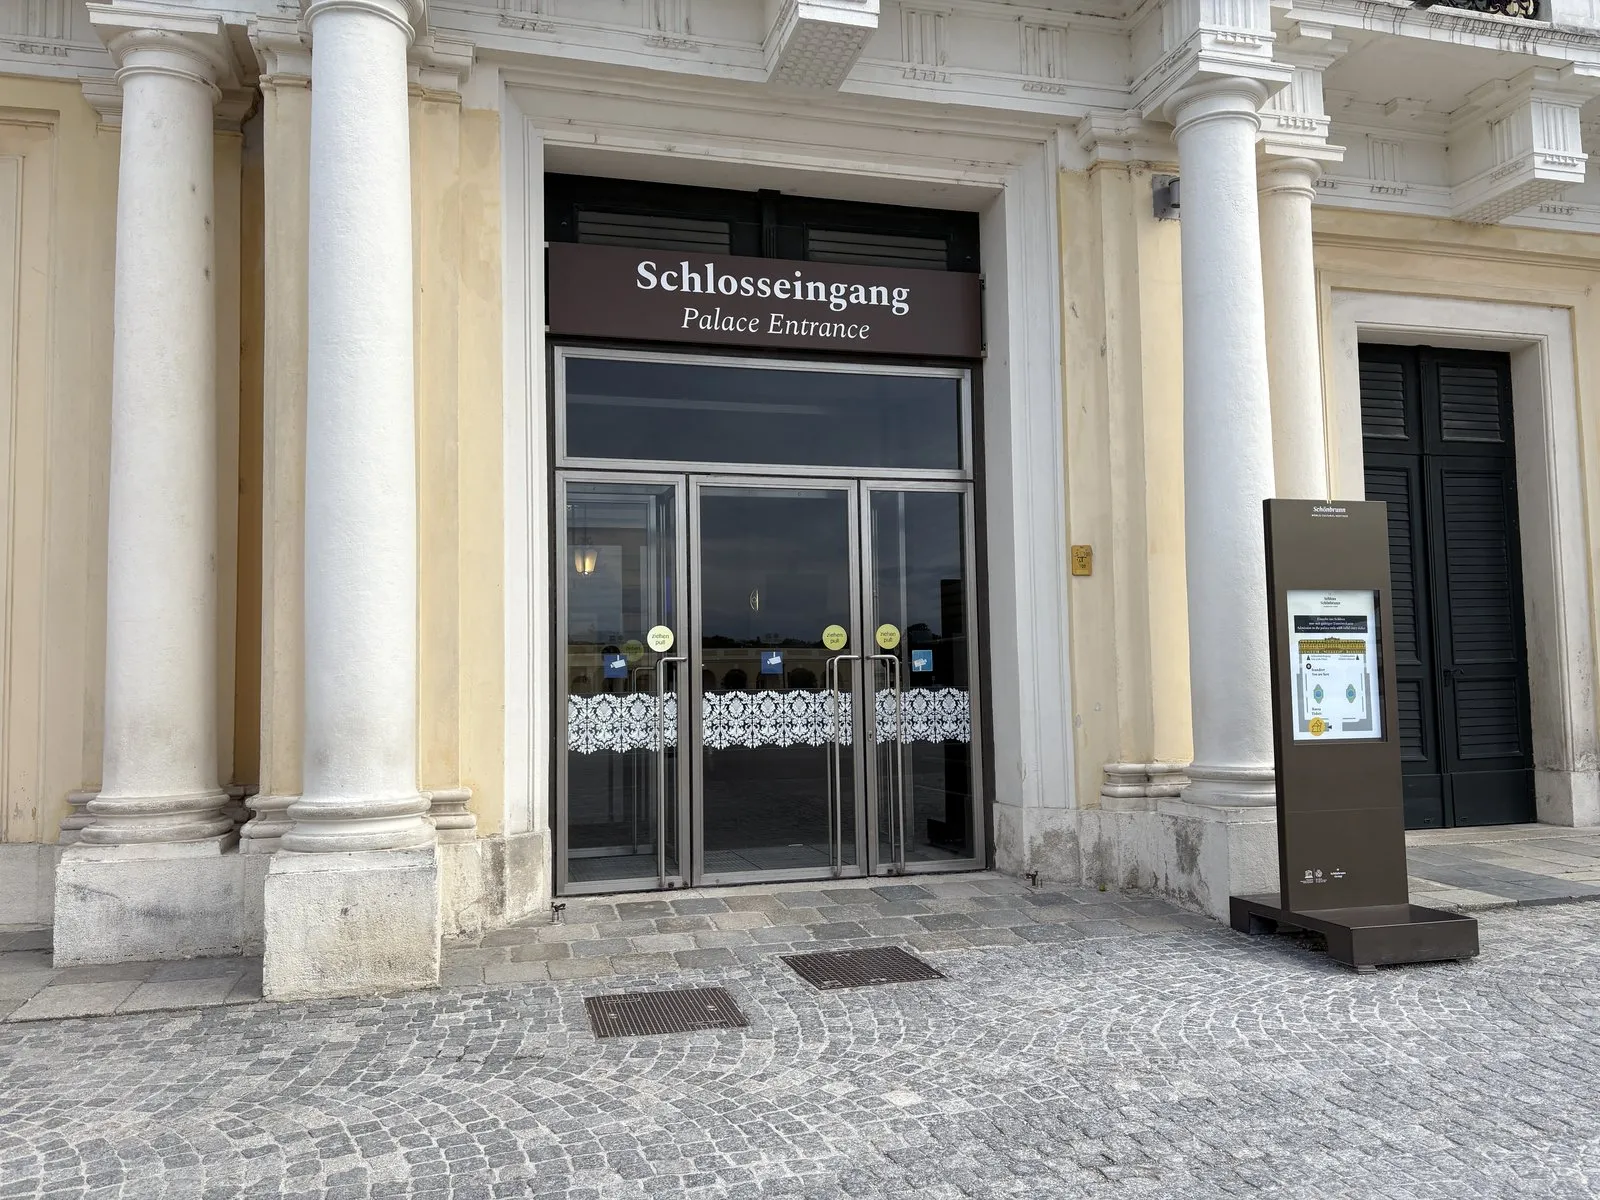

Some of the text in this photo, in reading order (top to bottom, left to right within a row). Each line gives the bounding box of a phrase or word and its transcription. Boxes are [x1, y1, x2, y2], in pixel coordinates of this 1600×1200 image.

[636, 260, 910, 315] Schlosseingang
[681, 307, 870, 340] Palace Entrance
[1312, 505, 1346, 513] Schönbrunn
